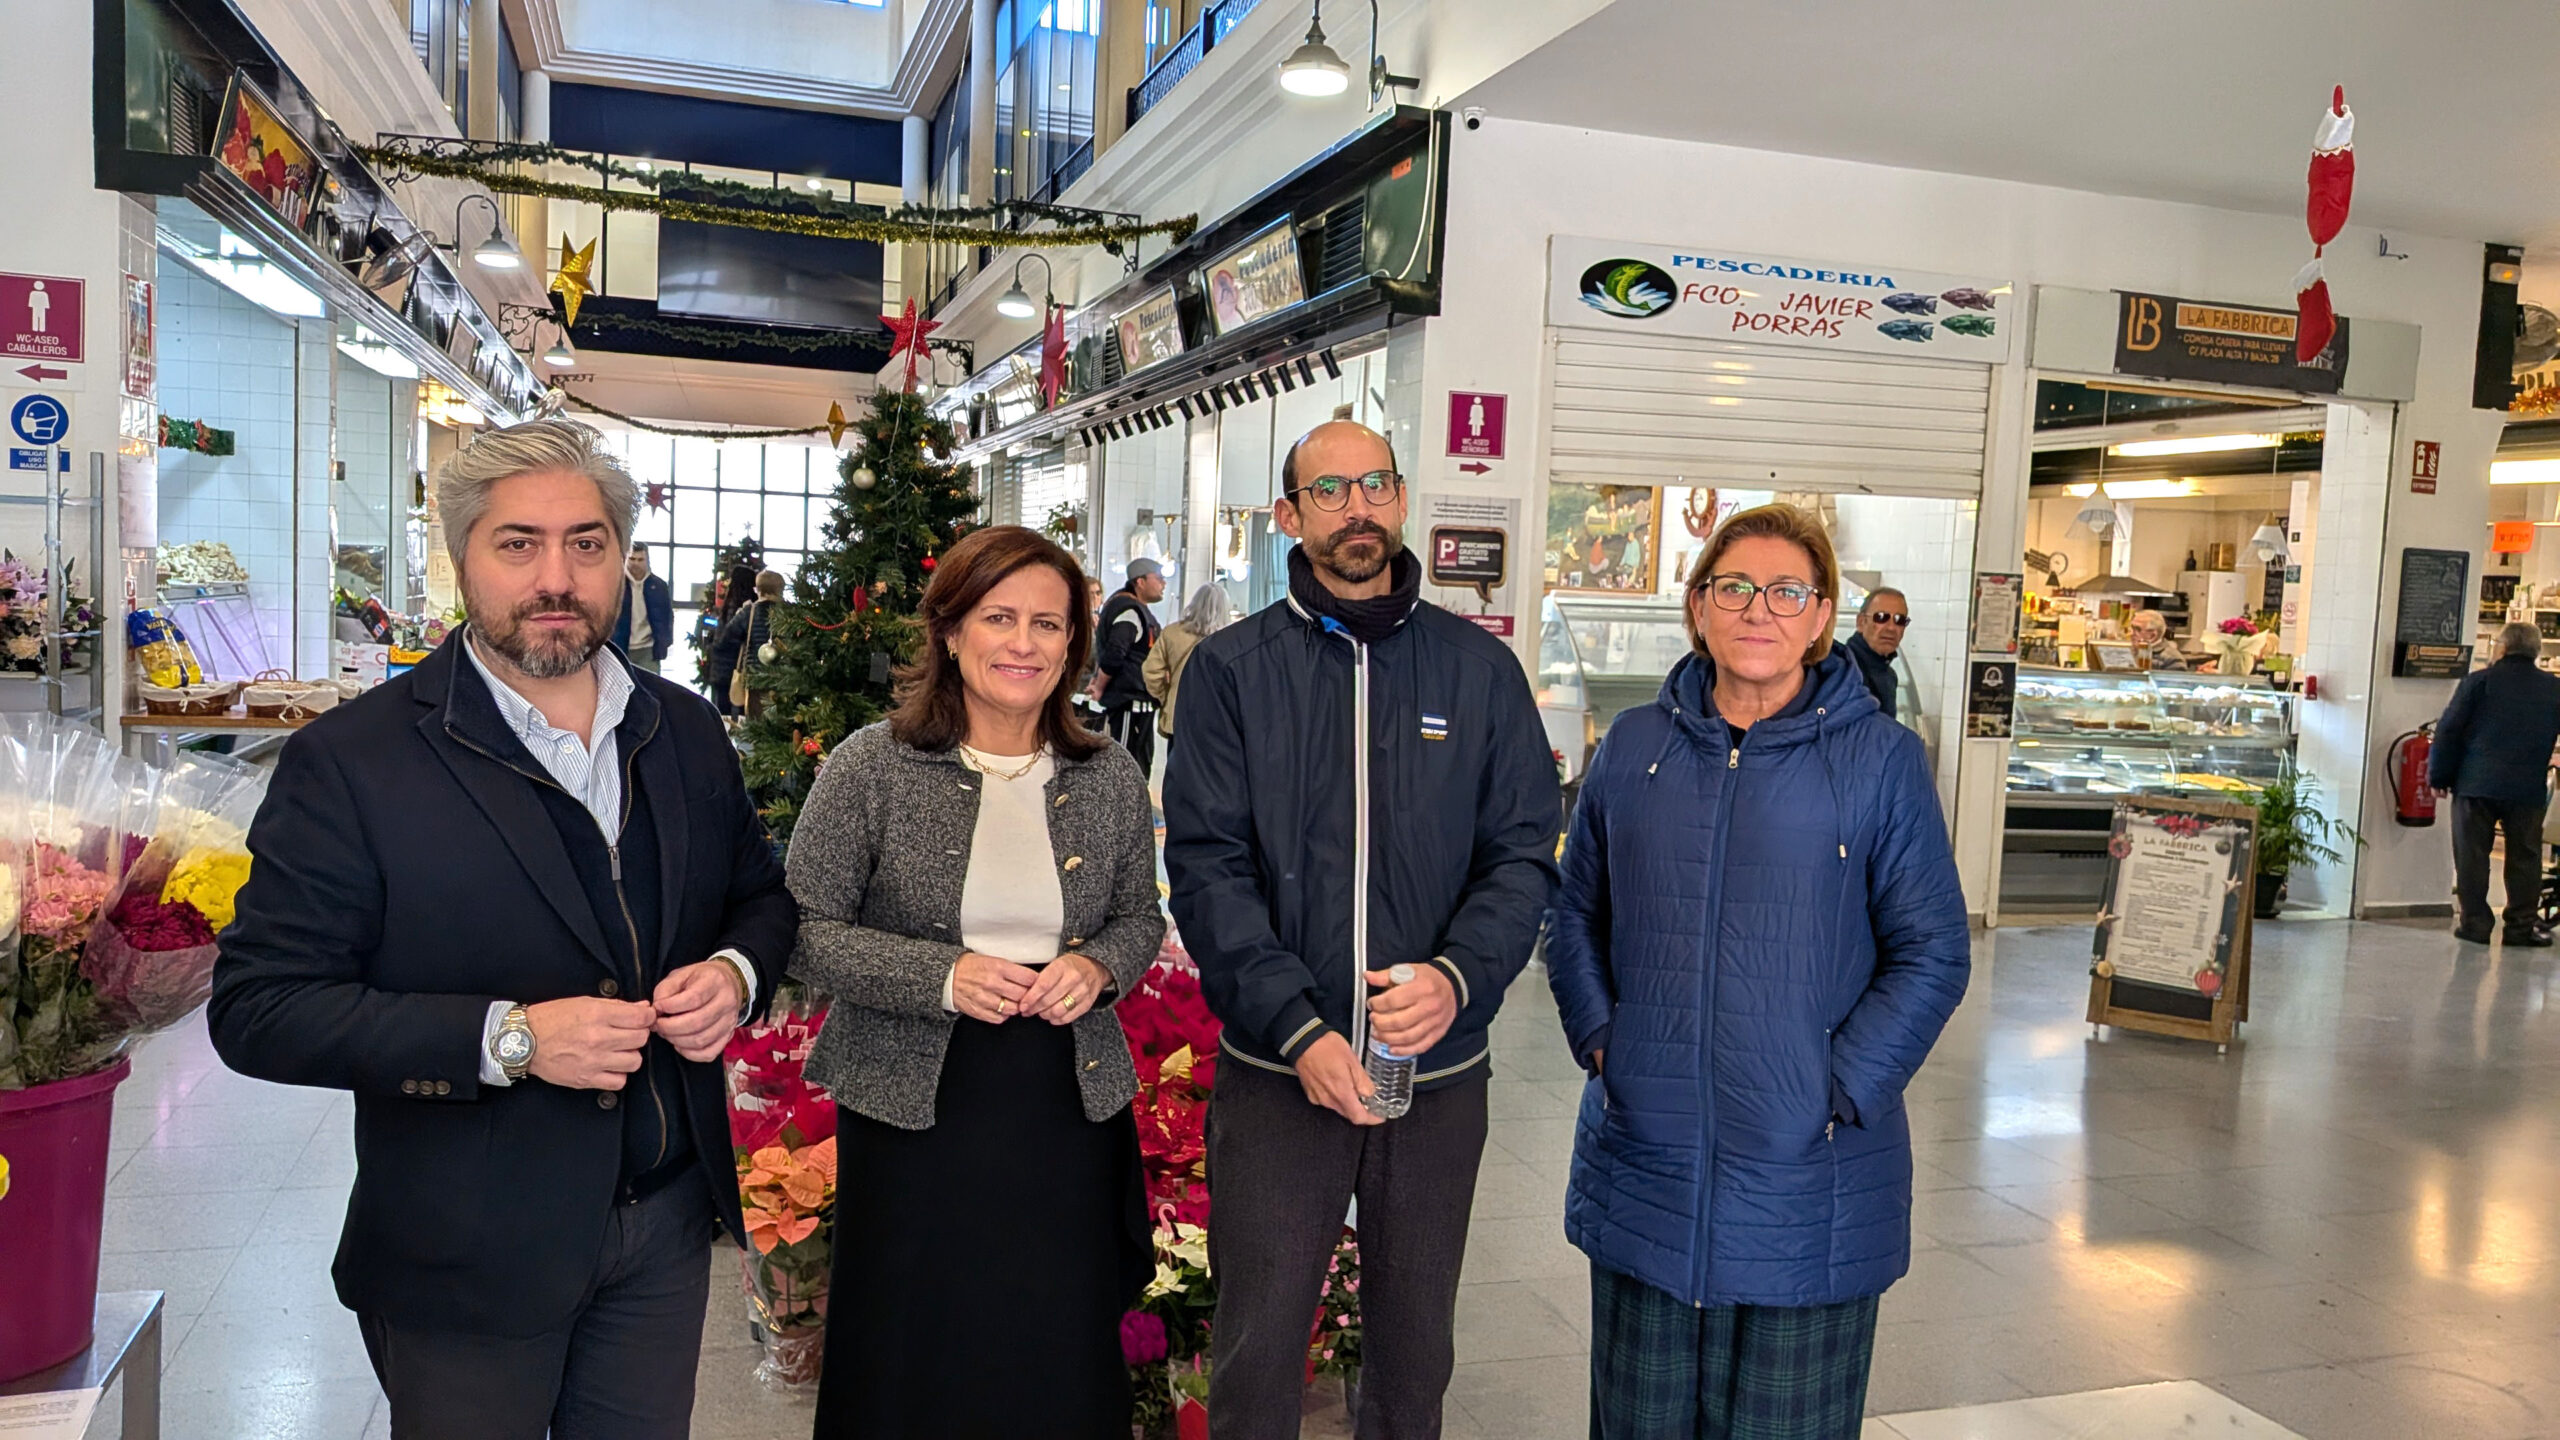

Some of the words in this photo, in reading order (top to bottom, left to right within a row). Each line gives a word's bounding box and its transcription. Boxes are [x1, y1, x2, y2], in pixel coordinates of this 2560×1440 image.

[1672, 254, 1897, 289] PESCADERIA
[1683, 283, 1745, 307] FCO.
[1780, 293, 1874, 320] JAVIER
[1731, 311, 1845, 339] PORRAS
[2187, 309, 2206, 326] LA
[2213, 311, 2290, 335] FABBRICA
[7, 343, 68, 356] CABALLEROS
[16, 334, 60, 345] WC-ASEO
[2184, 334, 2214, 345] COMIDA
[2262, 342, 2287, 352] LLEVAR
[2199, 348, 2223, 358] PLAZA
[1440, 539, 1456, 559] P
